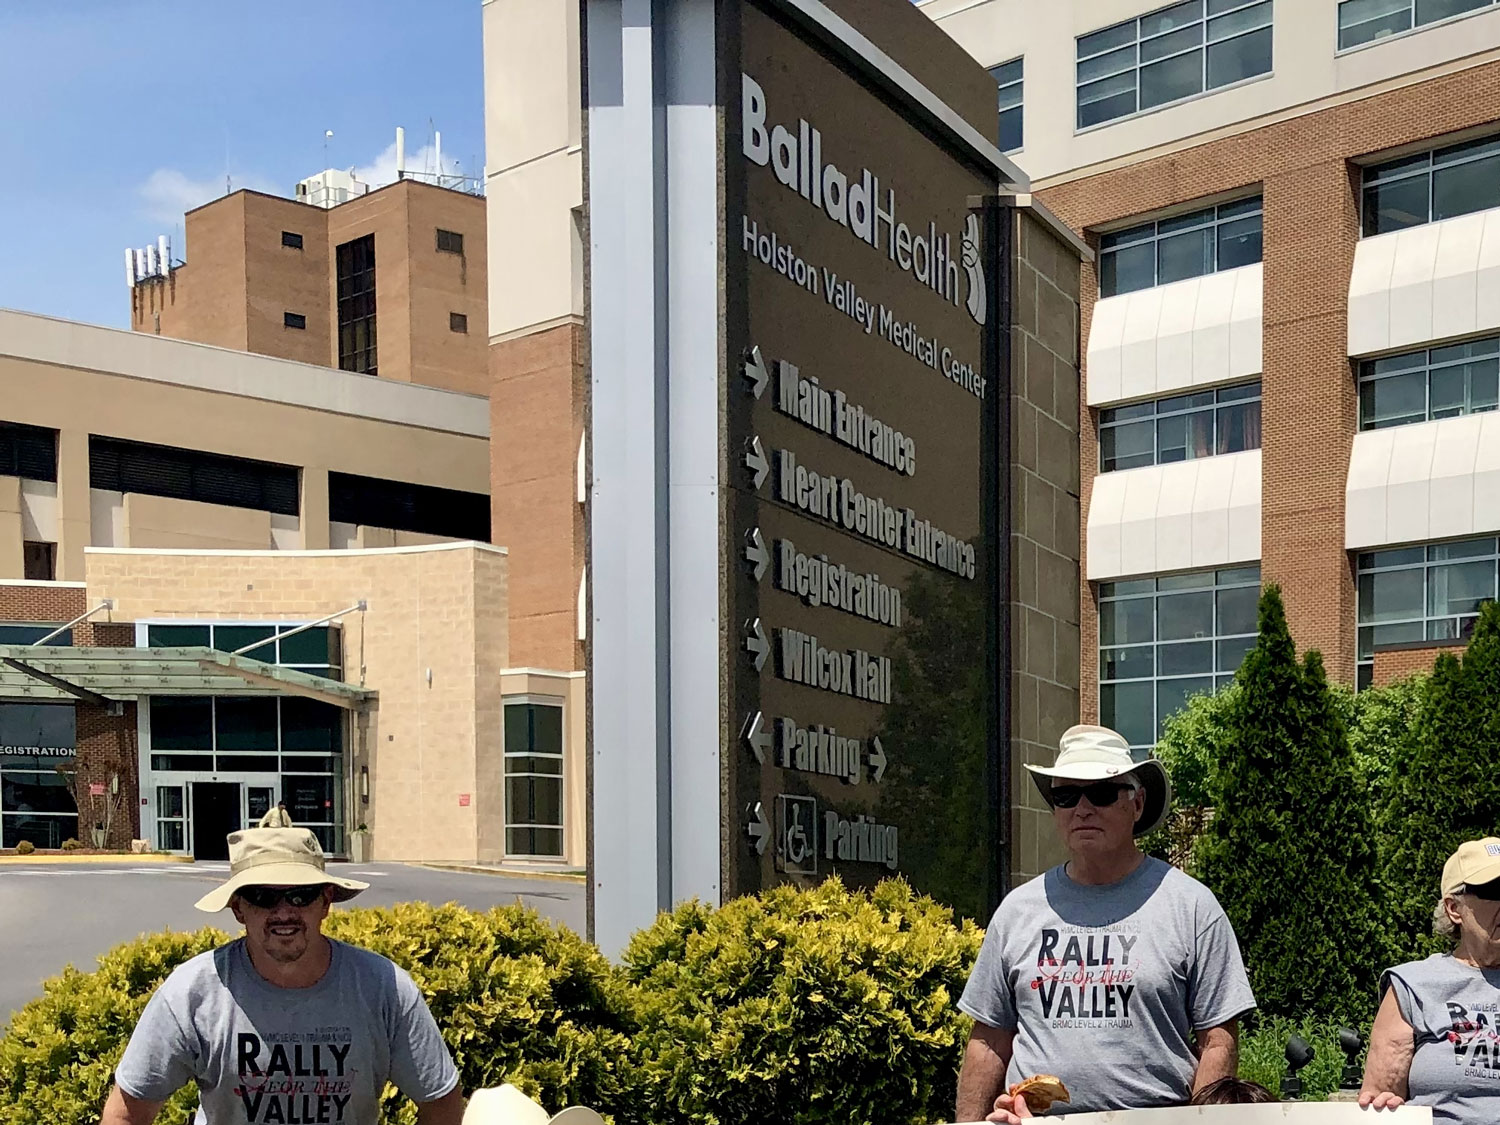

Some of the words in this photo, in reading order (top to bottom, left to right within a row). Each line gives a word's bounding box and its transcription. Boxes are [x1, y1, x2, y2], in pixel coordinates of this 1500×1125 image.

[743, 215, 818, 294] Holston
[823, 266, 875, 334] Valley
[879, 304, 938, 368] Medical
[941, 346, 987, 399] Center
[779, 359, 832, 430] Main
[836, 389, 916, 477] Entrance
[780, 449, 839, 523] Heart
[841, 479, 903, 550] Center
[905, 506, 976, 580] Entrance
[780, 538, 902, 627] Registration
[782, 627, 853, 696] Wilcox
[856, 651, 891, 703] Hall
[782, 717, 861, 784] Parking
[825, 811, 898, 870] Parking
[1037, 929, 1138, 967] RALLY
[1036, 976, 1134, 1019] VALLEY
[1061, 971, 1095, 984] FOR
[1098, 969, 1134, 983] THE
[1074, 1020, 1097, 1029] LEVEL
[1104, 1019, 1134, 1029] TRAUMA
[238, 1033, 351, 1077] RALLY
[239, 1085, 351, 1124] VALLEY
[268, 1081, 304, 1093] FOR
